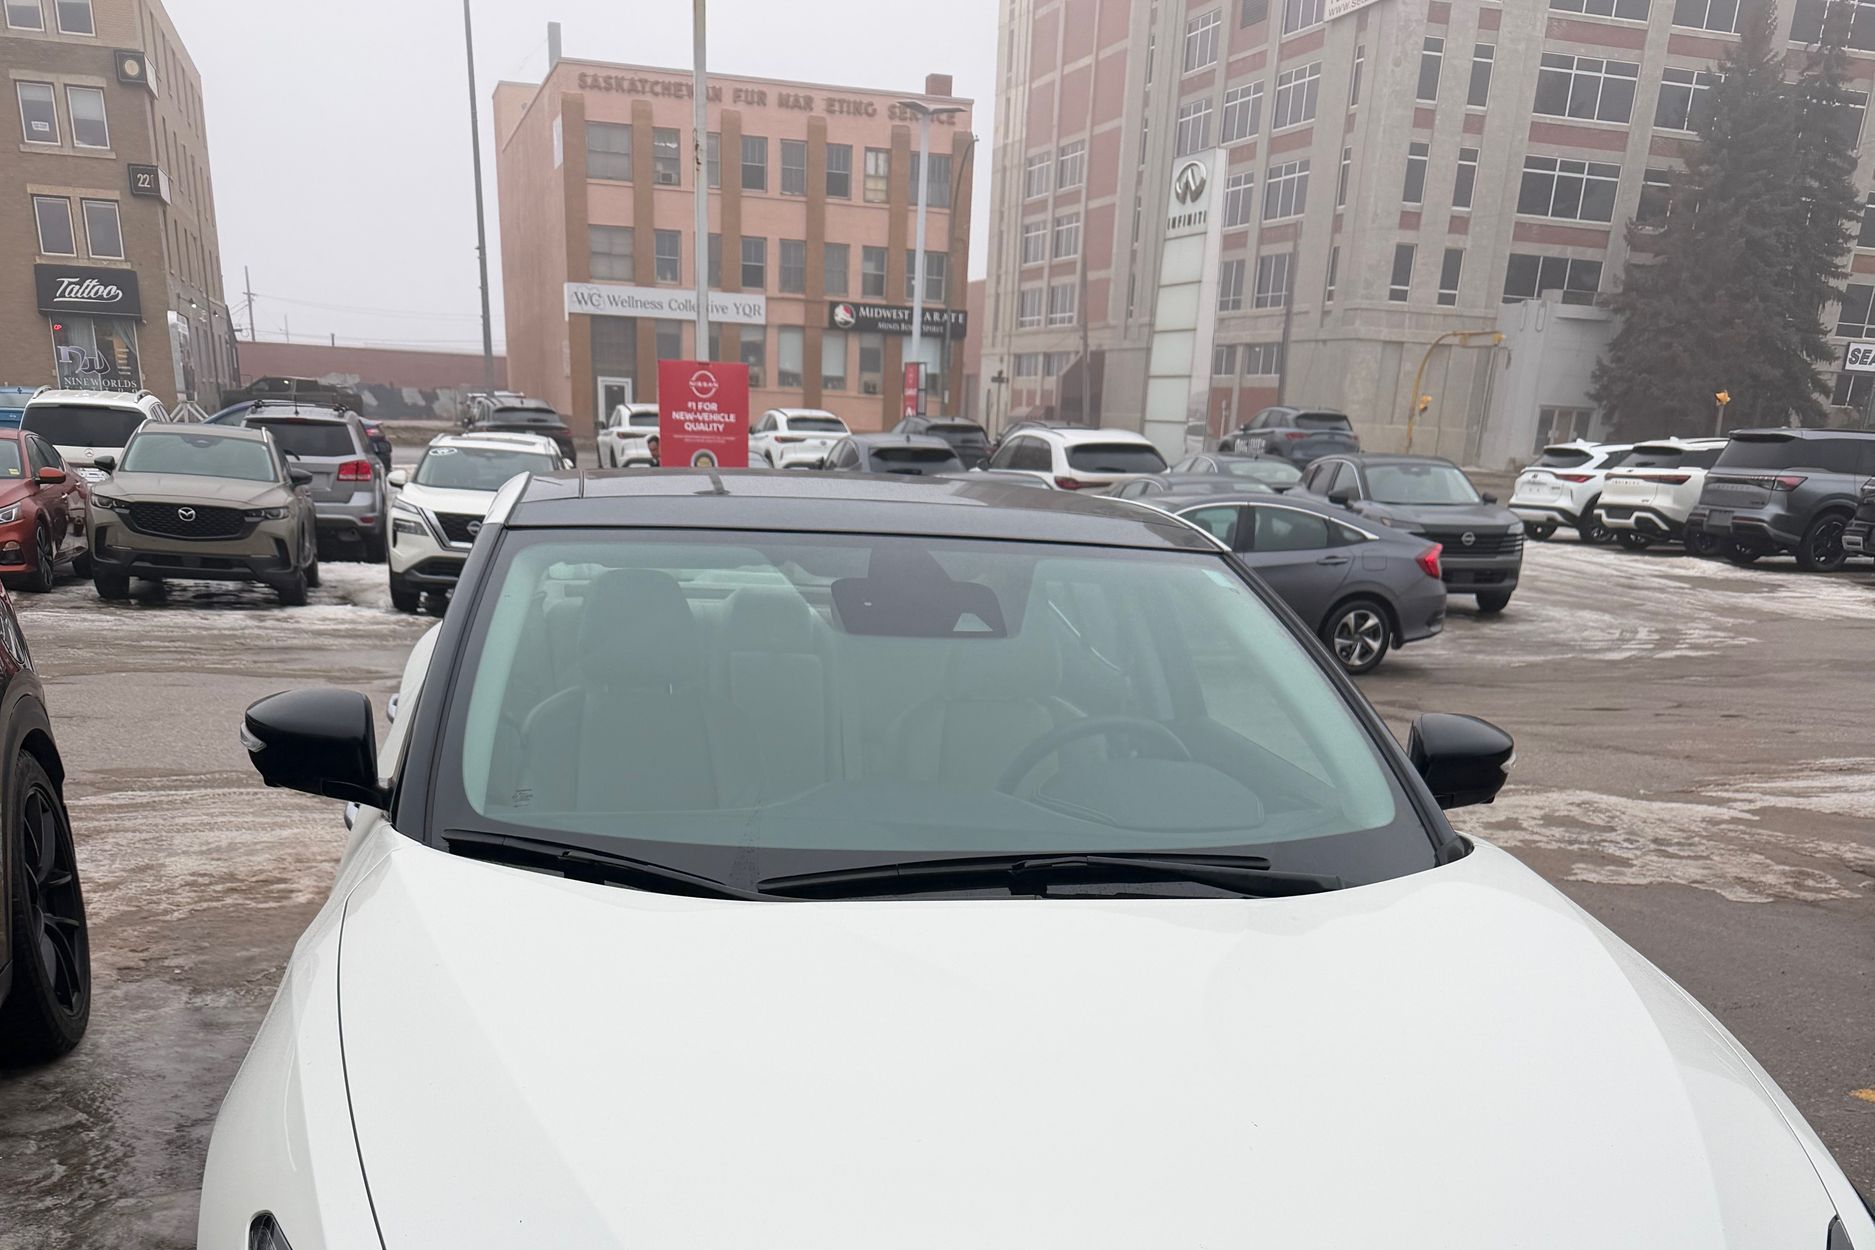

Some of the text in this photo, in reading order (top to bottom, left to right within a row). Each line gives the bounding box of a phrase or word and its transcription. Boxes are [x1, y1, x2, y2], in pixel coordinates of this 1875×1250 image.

[733, 88, 767, 106] FUR
[888, 103, 956, 126] SERICE
[1167, 210, 1206, 230] INFINITI
[54, 278, 122, 302] Tattoo
[607, 294, 664, 310] Wellness
[668, 299, 728, 314] Colleive
[733, 303, 762, 317] YQR
[859, 306, 965, 324] MIDWEST ARATE
[697, 402, 718, 411] FOR
[672, 411, 736, 422] NEW-VEHICLE
[684, 422, 725, 432] QUALITY
